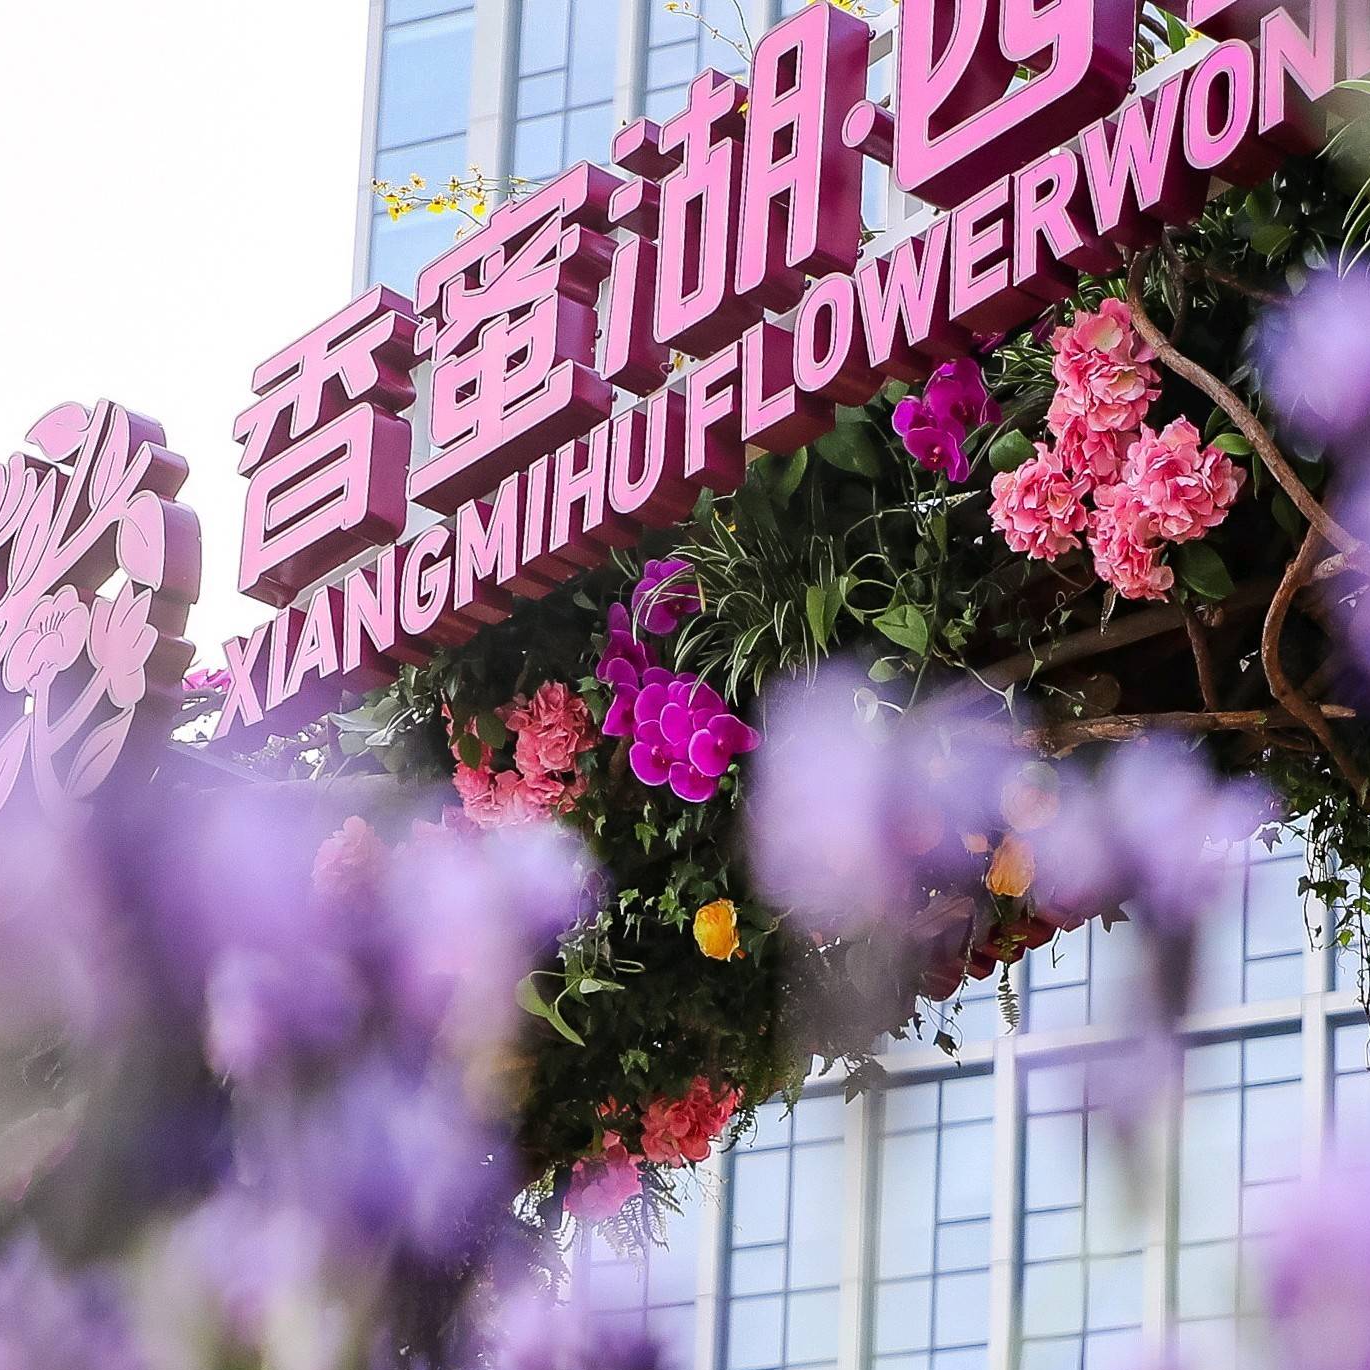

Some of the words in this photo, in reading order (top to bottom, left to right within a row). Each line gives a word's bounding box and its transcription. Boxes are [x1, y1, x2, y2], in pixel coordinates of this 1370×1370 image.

[233, 0, 1228, 592] 香蜜湖·四
[210, 388, 668, 742] XIANGMIHU
